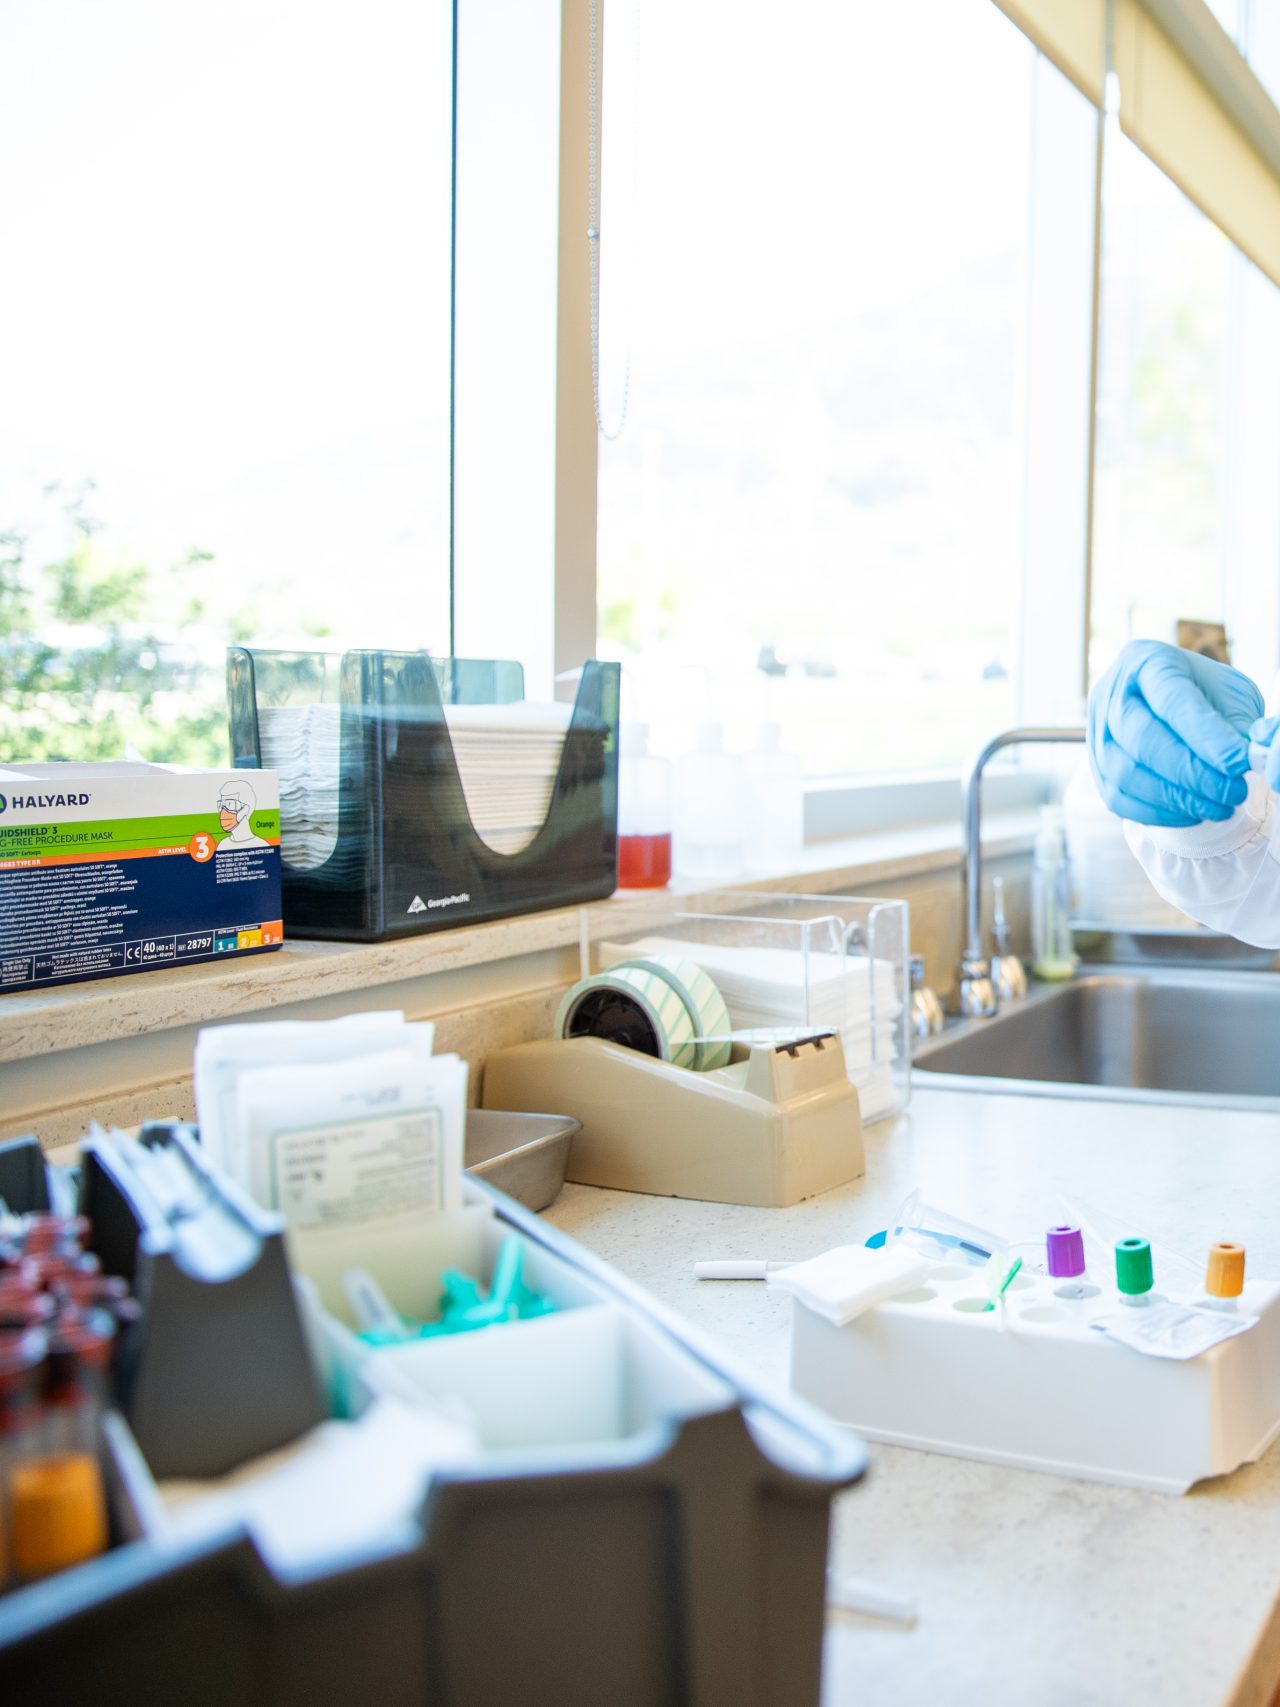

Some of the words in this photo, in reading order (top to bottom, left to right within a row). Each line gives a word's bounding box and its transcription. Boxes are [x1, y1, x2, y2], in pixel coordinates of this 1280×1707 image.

[12, 793, 90, 809] HALYARD
[52, 826, 58, 835] 3
[256, 820, 275, 830] Orange
[36, 833, 89, 845] PROCEDURE
[91, 831, 113, 841] MASK
[172, 846, 187, 854] LEVEL
[195, 836, 209, 859] 3
[187, 937, 212, 950] 28797
[240, 937, 247, 948] 2
[264, 933, 271, 944] 3
[143, 942, 155, 953] 40
[218, 941, 224, 951] 1
